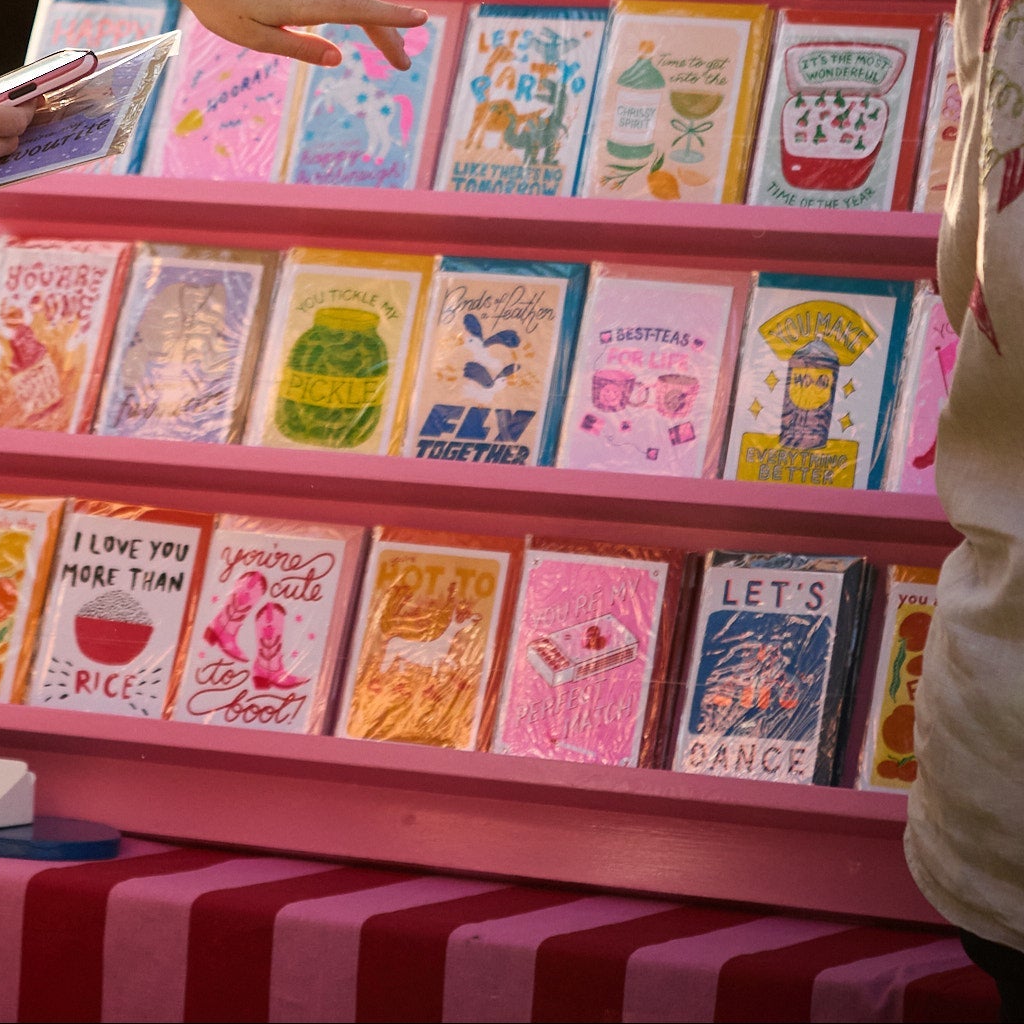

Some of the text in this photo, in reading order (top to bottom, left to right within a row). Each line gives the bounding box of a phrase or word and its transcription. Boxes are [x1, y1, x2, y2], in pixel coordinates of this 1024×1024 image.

[50, 17, 151, 48] HAPPY
[706, 58, 731, 76] get
[803, 67, 880, 83] WONDERFUL
[830, 54, 853, 66] THE
[855, 55, 892, 71] MOST
[705, 73, 728, 86] the
[454, 162, 487, 176] LIKE
[542, 168, 563, 182] NO
[766, 181, 876, 210] TIME OF THE YEAR
[296, 288, 400, 320] YOU TICKLE MY
[616, 327, 691, 347] BEST-TEAS
[769, 312, 870, 354] YOU MAKE
[606, 347, 689, 371] FOR LIFE
[286, 374, 378, 405] PICKLE
[419, 403, 537, 442] FLY
[416, 439, 530, 466] TOGETHER
[745, 448, 848, 469] EVERYTHING
[758, 466, 835, 484] BETTER
[73, 531, 190, 562] I LOVE YOU
[219, 542, 324, 583] you're
[61, 563, 185, 593] MORE THAN
[269, 568, 323, 602] cute
[377, 562, 497, 599] HOT TO
[722, 578, 825, 610] LET'S
[898, 593, 929, 609] you
[75, 670, 137, 700] RICE
[195, 659, 250, 686] to
[689, 741, 806, 776] DANCE
